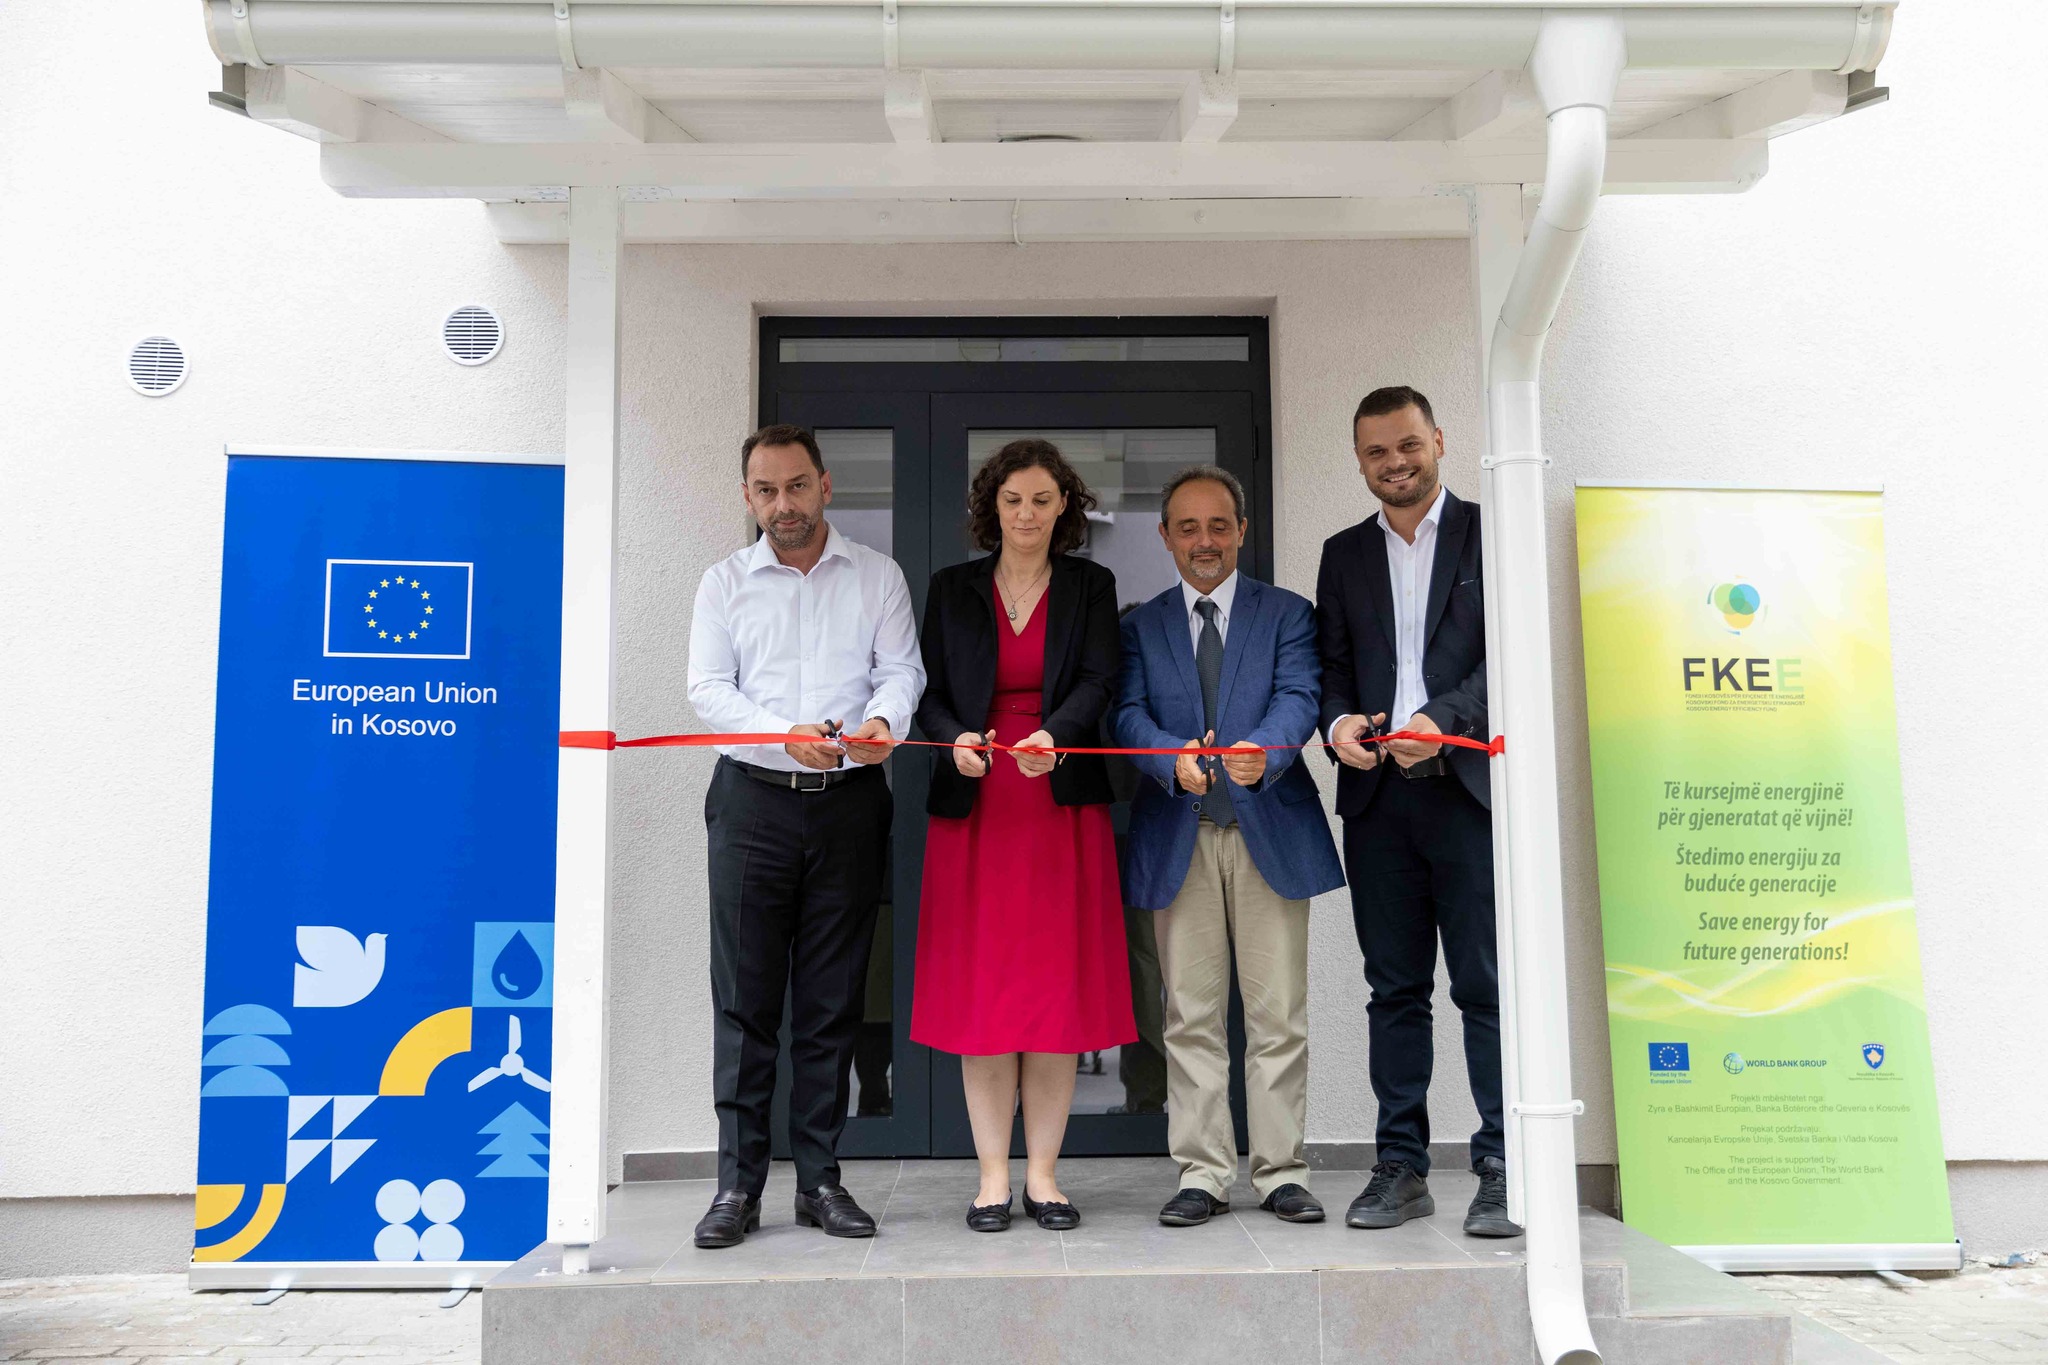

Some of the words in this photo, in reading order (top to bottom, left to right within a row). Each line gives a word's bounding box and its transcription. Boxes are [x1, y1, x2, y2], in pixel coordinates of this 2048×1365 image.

[1682, 657, 1805, 692] FKEE
[292, 678, 416, 707] European
[424, 681, 498, 704] Union
[331, 713, 353, 735] in
[361, 713, 457, 737] Kosovo
[1664, 781, 1681, 800] Të
[1683, 781, 1761, 805] kursejmë
[1763, 782, 1845, 806] energjinë
[1657, 807, 1685, 830] për
[1688, 808, 1779, 831] gjeneratat
[1781, 808, 1802, 832] që
[1805, 808, 1854, 832] vijnë!
[1675, 842, 1745, 866] Štedimo
[1749, 847, 1818, 871] energiju
[1821, 851, 1841, 866] za
[1684, 873, 1745, 892] buduće
[1749, 873, 1837, 898] generacije
[1698, 911, 1739, 931] Save
[1742, 915, 1800, 935] energy
[1803, 911, 1829, 931] for
[1683, 940, 1737, 960] future
[1740, 941, 1849, 966] generations!
[1647, 1105, 1666, 1114] Zyra
[1675, 1104, 1714, 1113] Bashkimit
[1716, 1104, 1754, 1114] Europian,
[1755, 1104, 1781, 1113] Banka
[1819, 1104, 1834, 1112] dhe
[1836, 1104, 1867, 1113] Qeveria
[1731, 1094, 1761, 1104] Projekti
[1667, 1135, 1712, 1145] Kancelarija
[1714, 1135, 1751, 1144] Evropske
[1778, 1135, 1810, 1143] Svetska
[1812, 1135, 1837, 1143] Banka
[1843, 1135, 1866, 1143] Vlada
[1868, 1135, 1899, 1143] Kosova
[1740, 1125, 1774, 1135] Projekat
[1684, 1166, 1700, 1175] The
[1702, 1166, 1726, 1175] Office
[1727, 1166, 1736, 1175] of
[1737, 1166, 1750, 1174] the
[1752, 1166, 1791, 1176] European
[1821, 1166, 1837, 1174] The
[1839, 1166, 1862, 1174] World
[1864, 1166, 1885, 1174] Bank
[1728, 1155, 1745, 1164] The
[1747, 1155, 1774, 1166] project
[1784, 1156, 1824, 1166] supported
[1727, 1177, 1743, 1185] and
[1745, 1176, 1758, 1185] the
[1760, 1176, 1790, 1185] Kosovo
